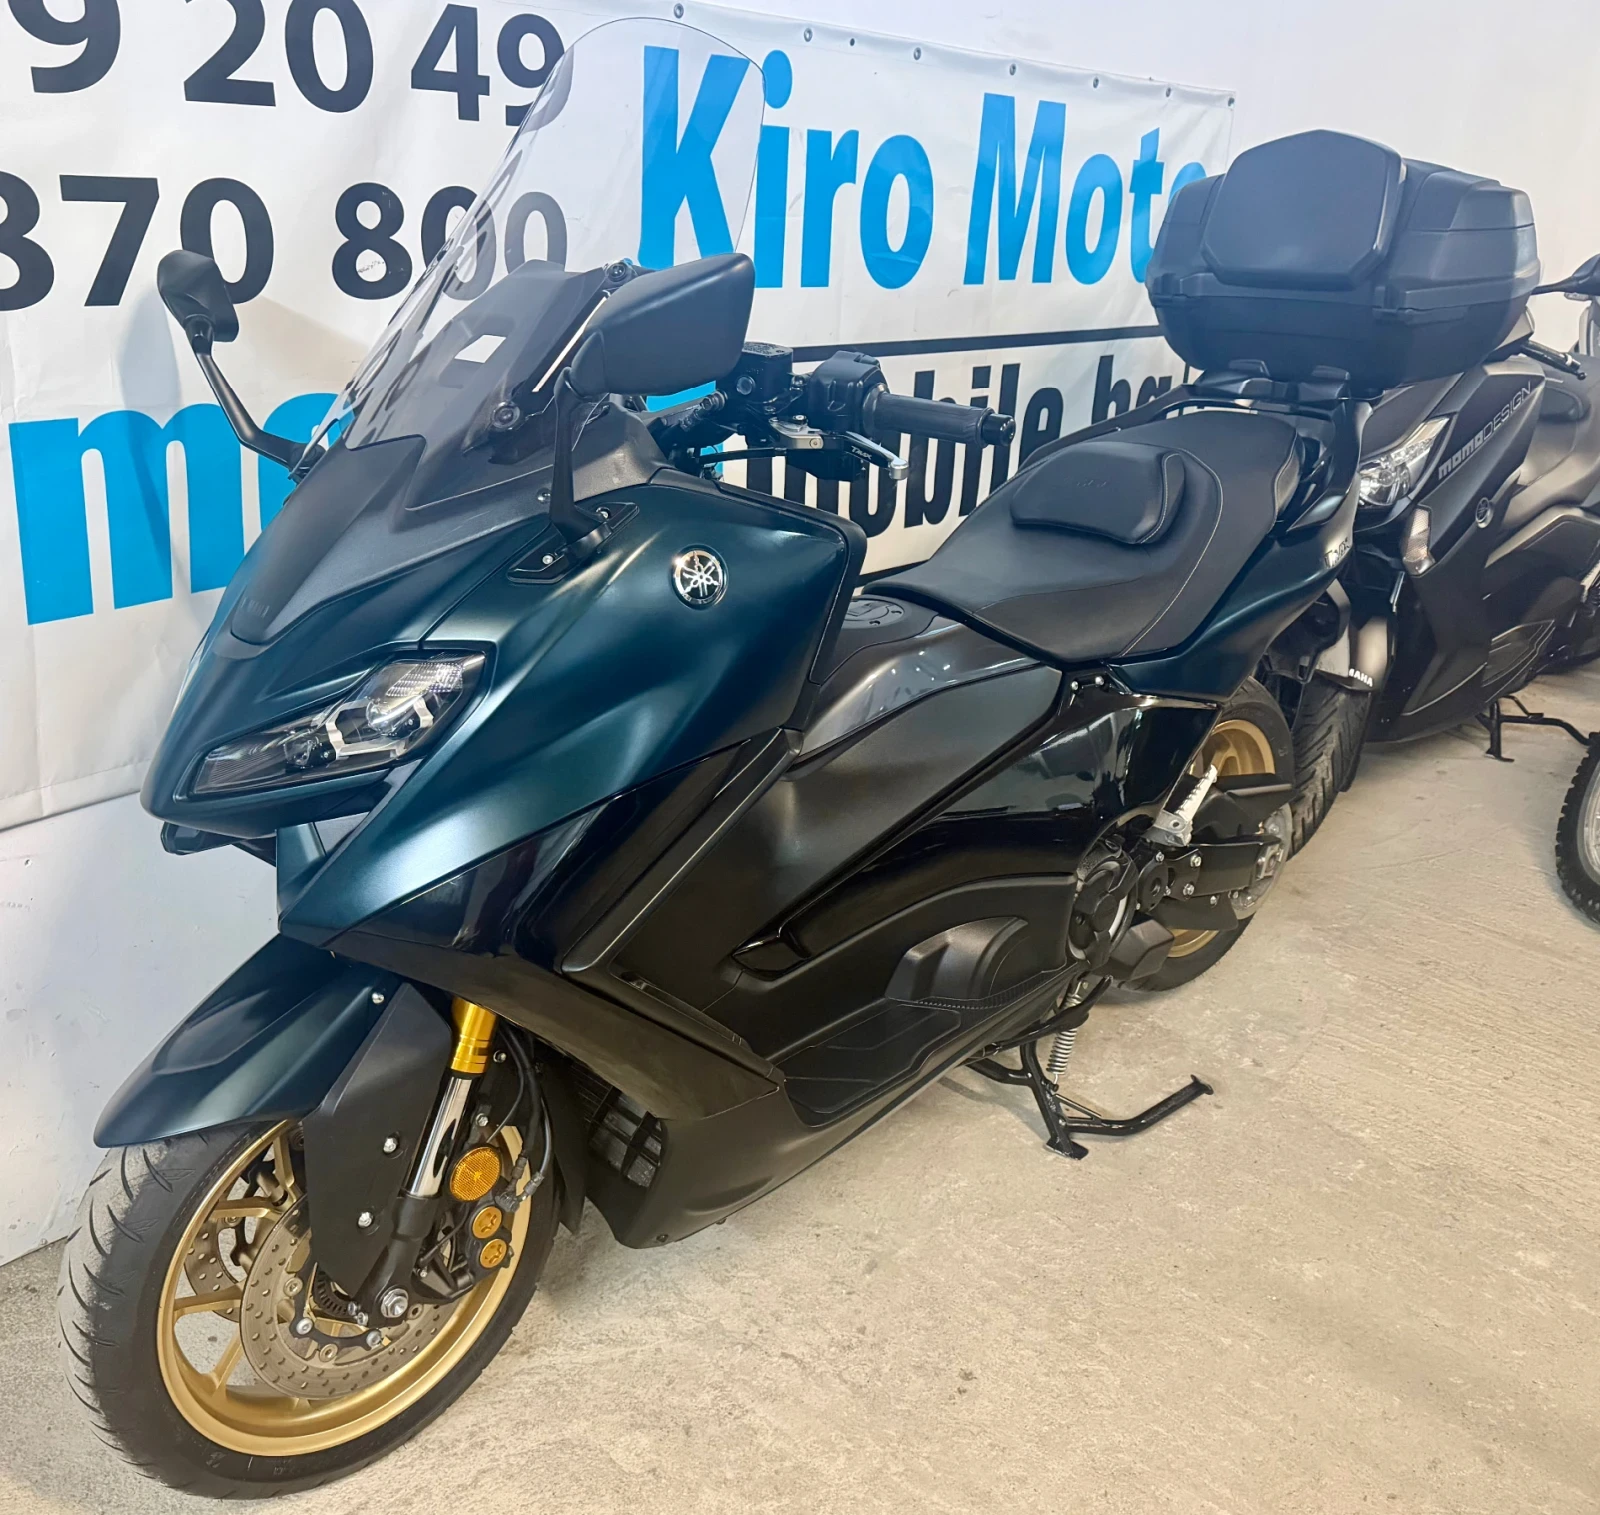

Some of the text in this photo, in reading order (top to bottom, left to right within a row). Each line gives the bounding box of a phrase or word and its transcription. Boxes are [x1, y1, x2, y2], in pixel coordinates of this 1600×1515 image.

[184, 0, 374, 113] 20
[411, 3, 574, 135] 49
[638, 46, 934, 289] Kiro
[332, 181, 567, 301] 800
[1348, 667, 1374, 688] MAHA
